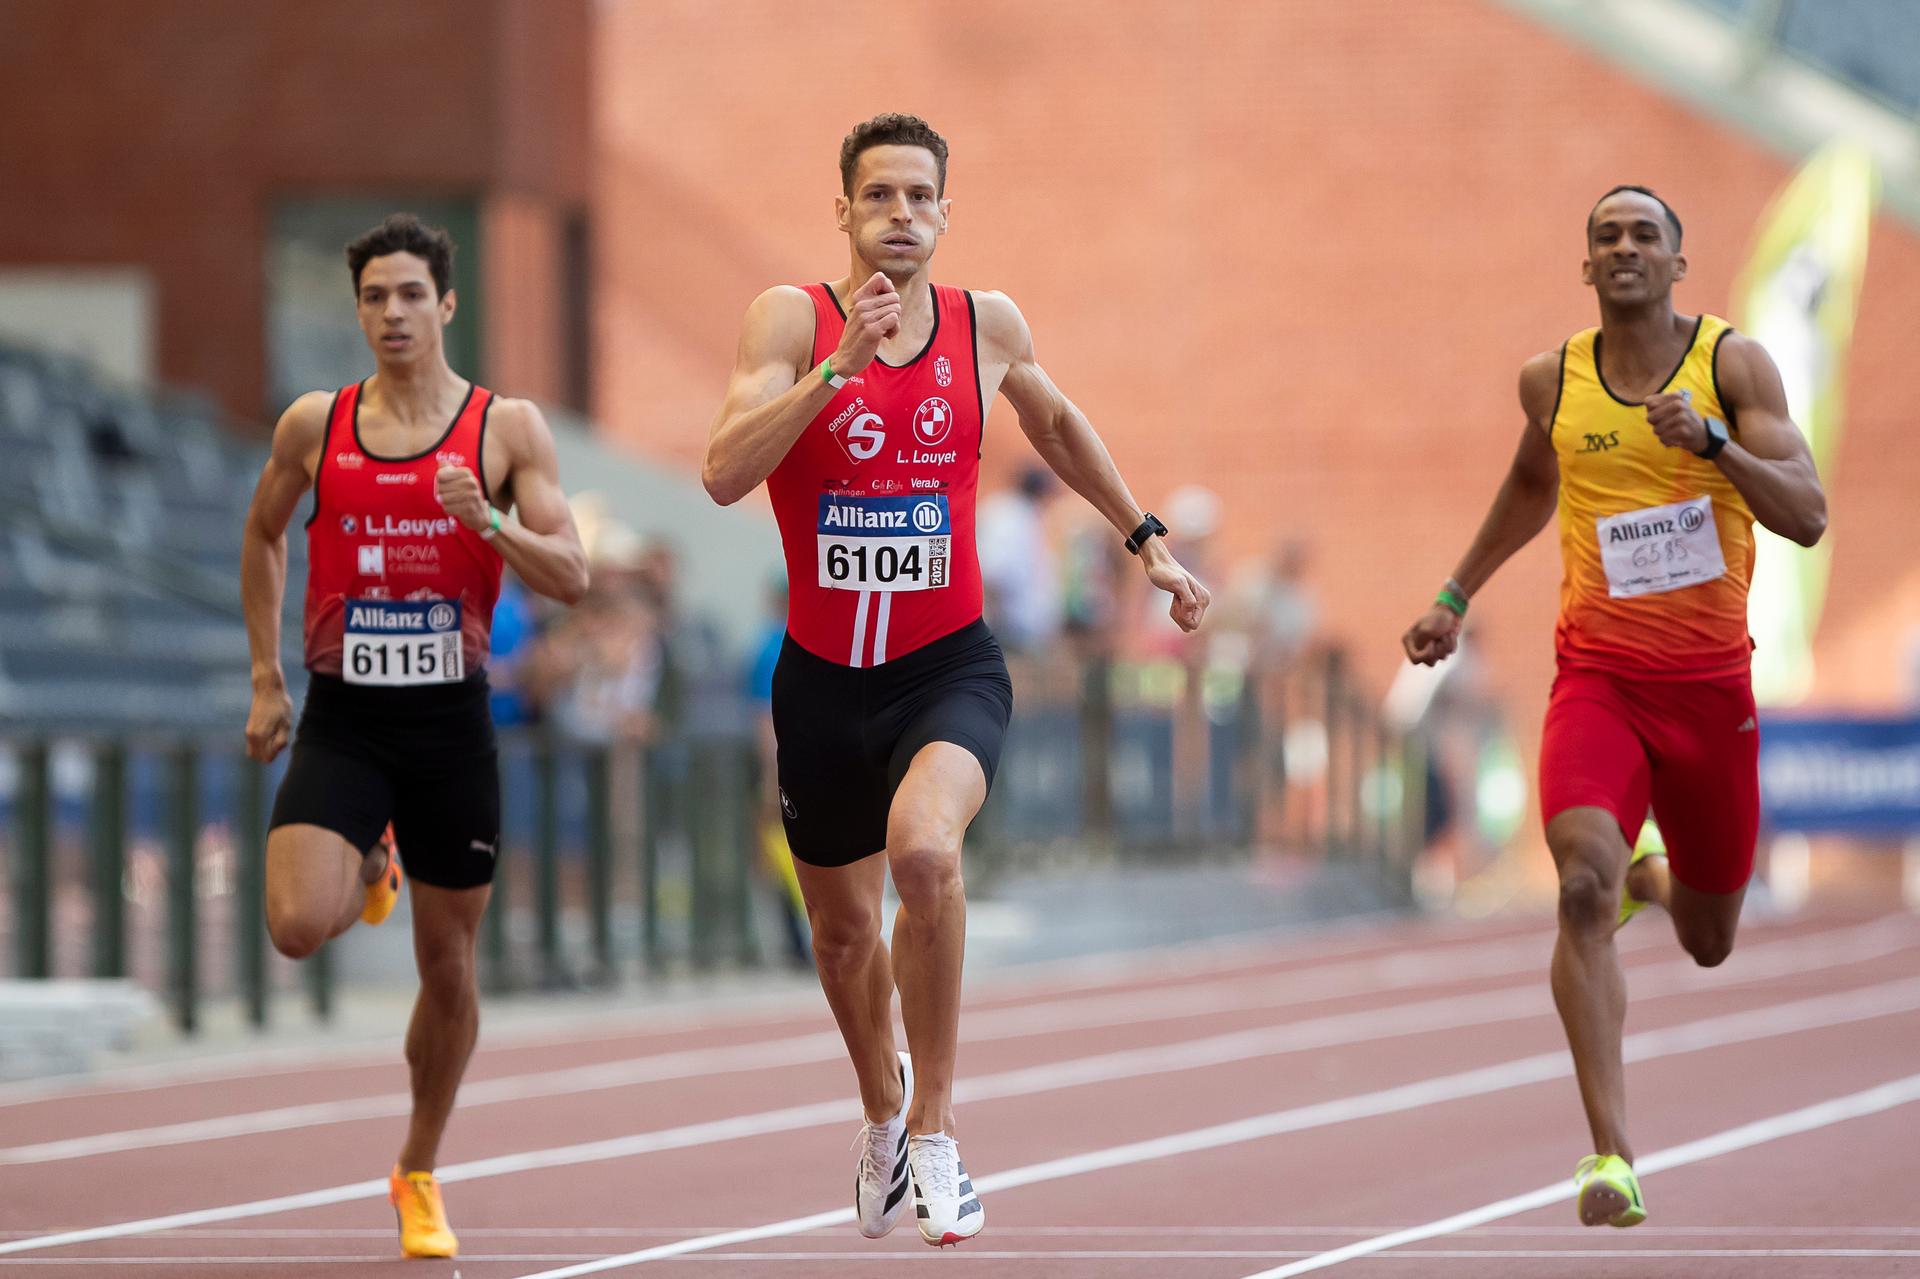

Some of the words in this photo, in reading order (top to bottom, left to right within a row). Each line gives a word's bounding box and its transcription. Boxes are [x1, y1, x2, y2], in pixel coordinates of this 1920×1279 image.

[828, 403, 856, 432] GROUP
[855, 397, 864, 406] S
[920, 400, 948, 414] BMW
[847, 413, 886, 460] S
[897, 450, 909, 463] L.
[913, 450, 957, 466] Louyet
[824, 504, 908, 529] Allianz
[1609, 518, 1675, 544] Allianz
[387, 545, 440, 561] NOVA
[827, 544, 923, 583] 6104
[1631, 537, 1689, 569] 6585
[932, 558, 944, 586] 2025
[350, 606, 425, 630] Allianz
[351, 642, 437, 676] 6115
